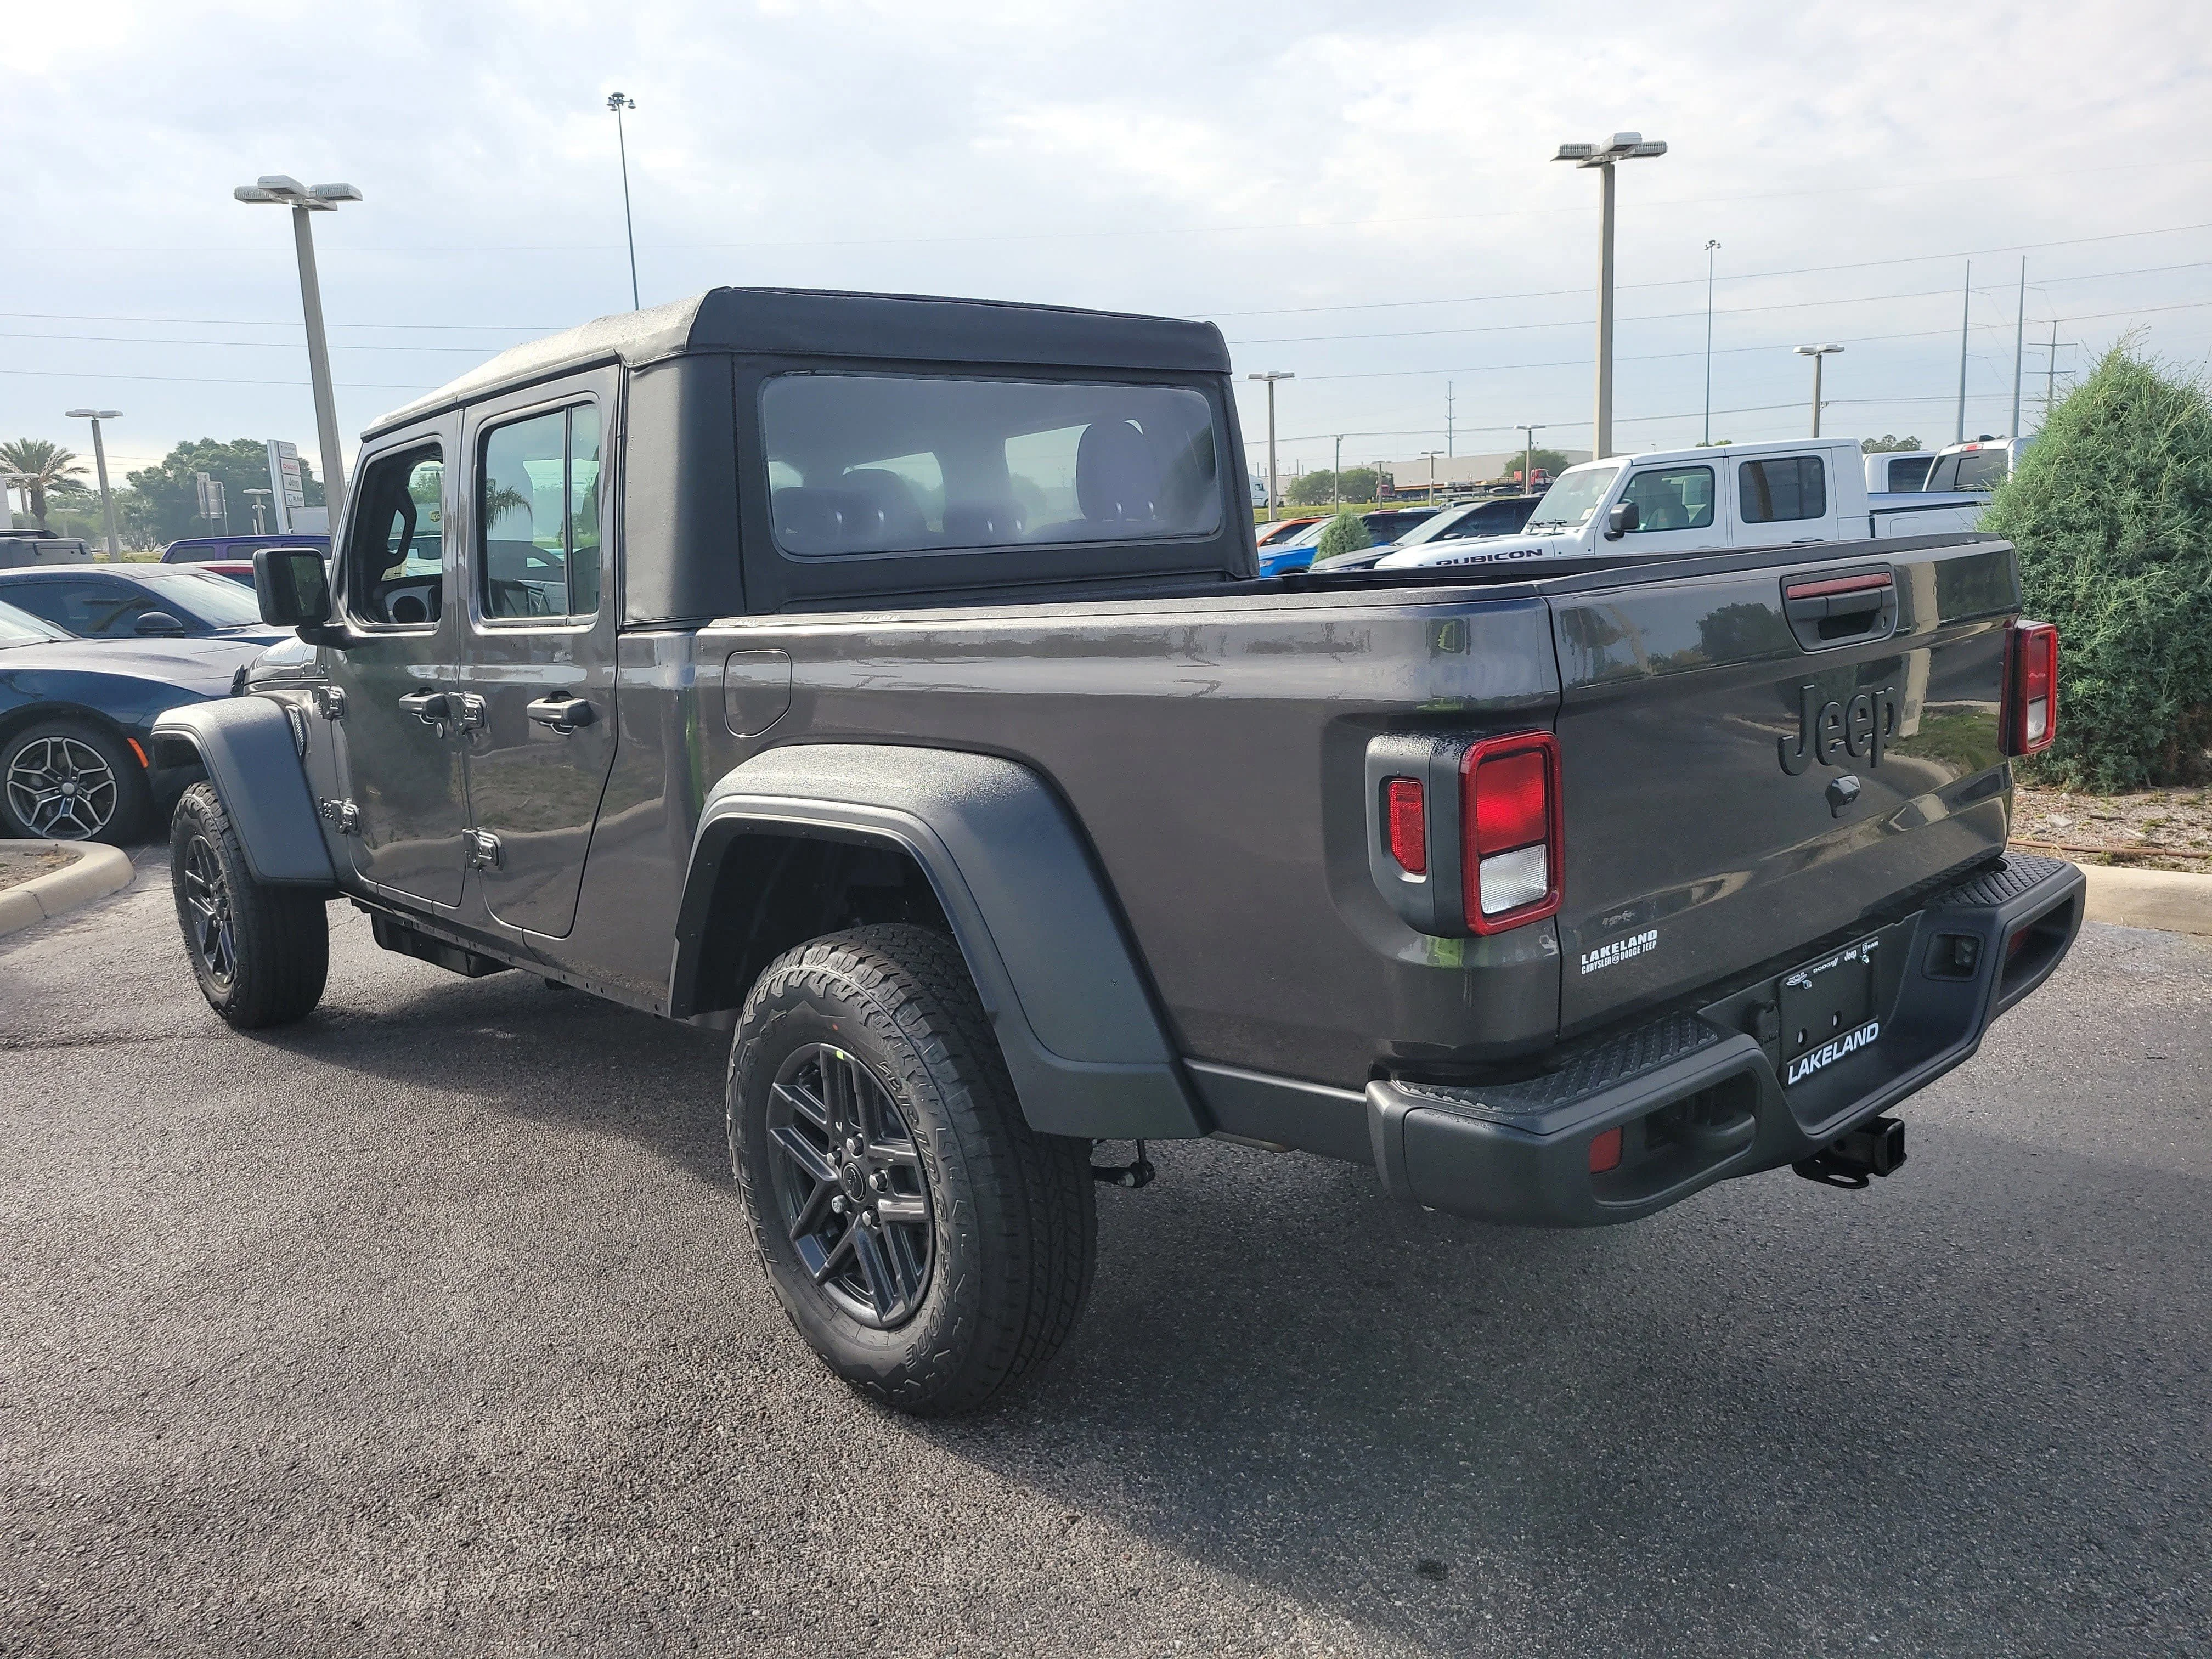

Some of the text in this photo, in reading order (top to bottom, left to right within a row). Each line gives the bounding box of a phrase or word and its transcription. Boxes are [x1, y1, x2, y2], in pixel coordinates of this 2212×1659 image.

[1778, 684, 1899, 776] Jeep
[1581, 929, 1657, 966] LAKELAND
[1581, 940, 1656, 975] CHRYSLER DODGE JEEP
[1813, 960, 1836, 973] DODGE
[1844, 950, 1857, 961] Jeep
[1867, 941, 1878, 949] RAM
[1788, 1022, 1879, 1085] LAKELAND
[876, 1059, 951, 1372] BRIDGESTONE
